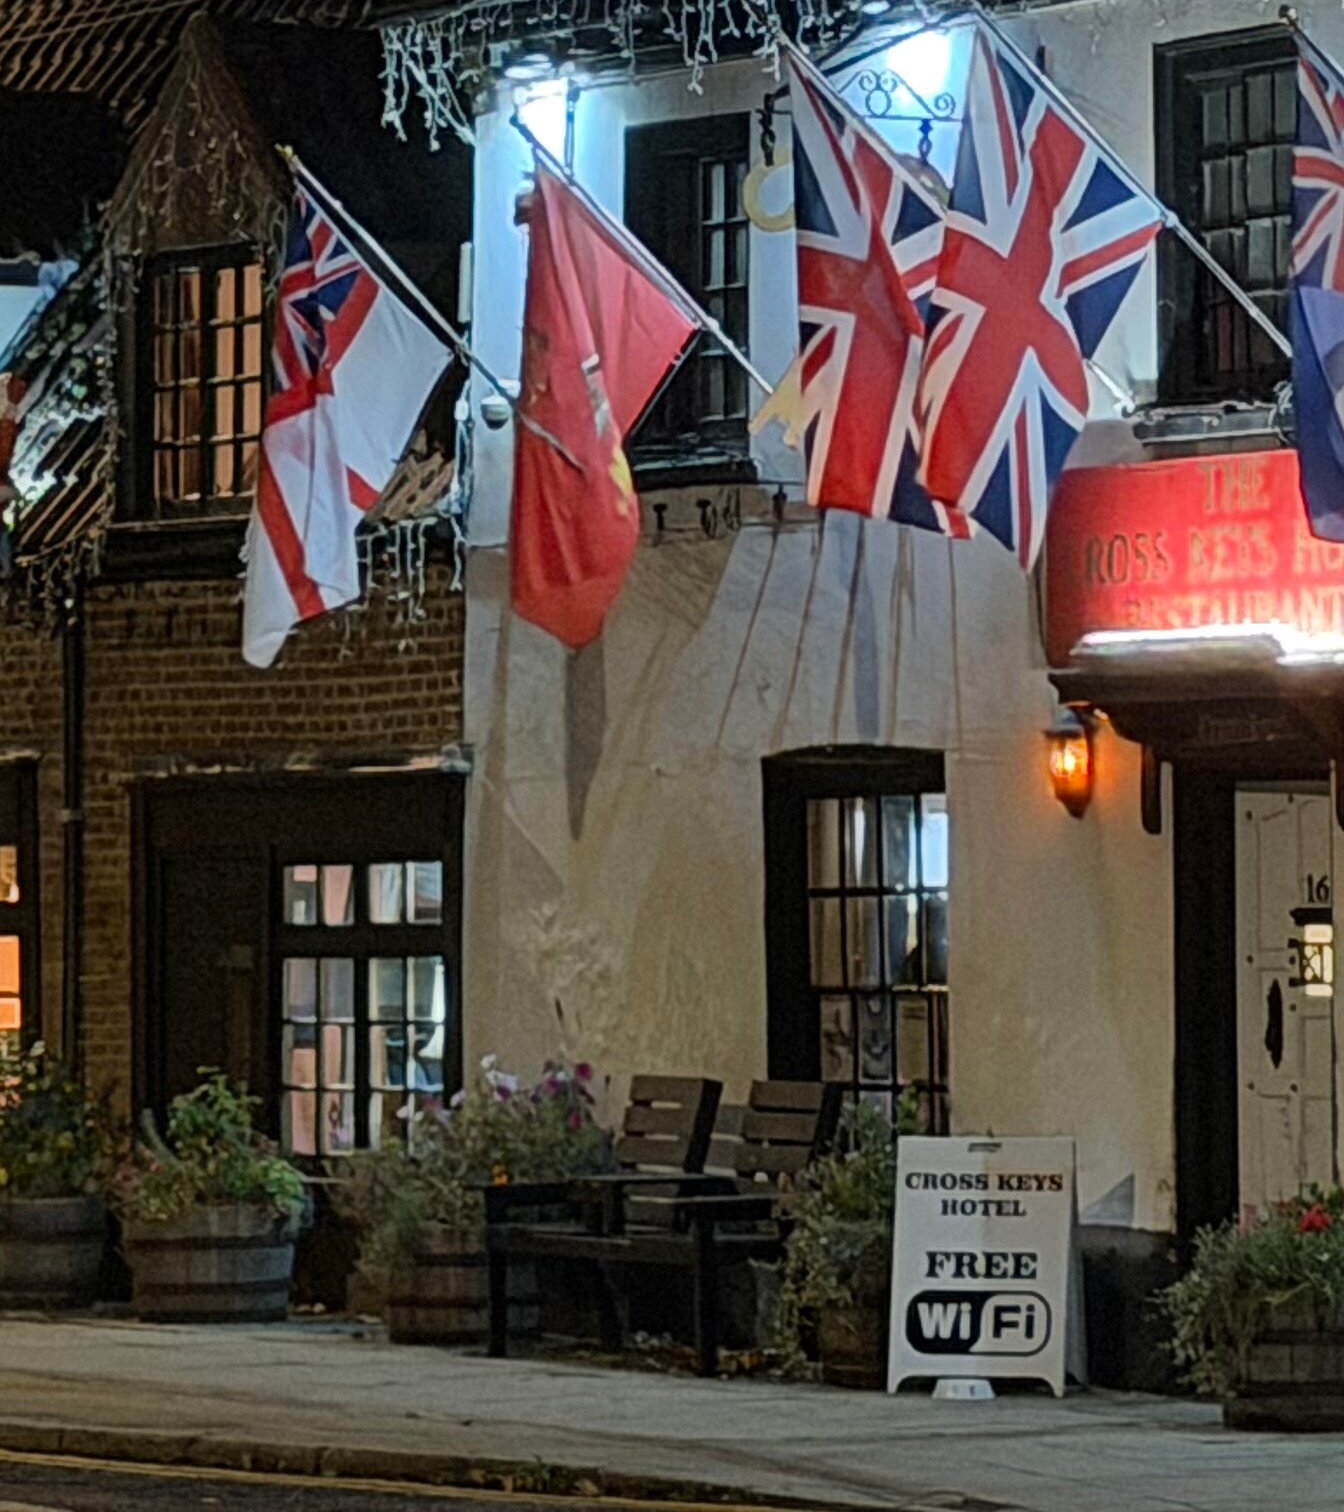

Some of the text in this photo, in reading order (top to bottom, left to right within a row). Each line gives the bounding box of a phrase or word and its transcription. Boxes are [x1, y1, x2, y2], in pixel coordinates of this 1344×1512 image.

[1197, 459, 1270, 514] THE
[1064, 528, 1173, 586] ROSS
[1305, 873, 1331, 903] 16
[904, 1171, 1065, 1193] CROSS KEYS
[940, 1198, 1027, 1217] HOTEL
[923, 1250, 1039, 1280] FREE
